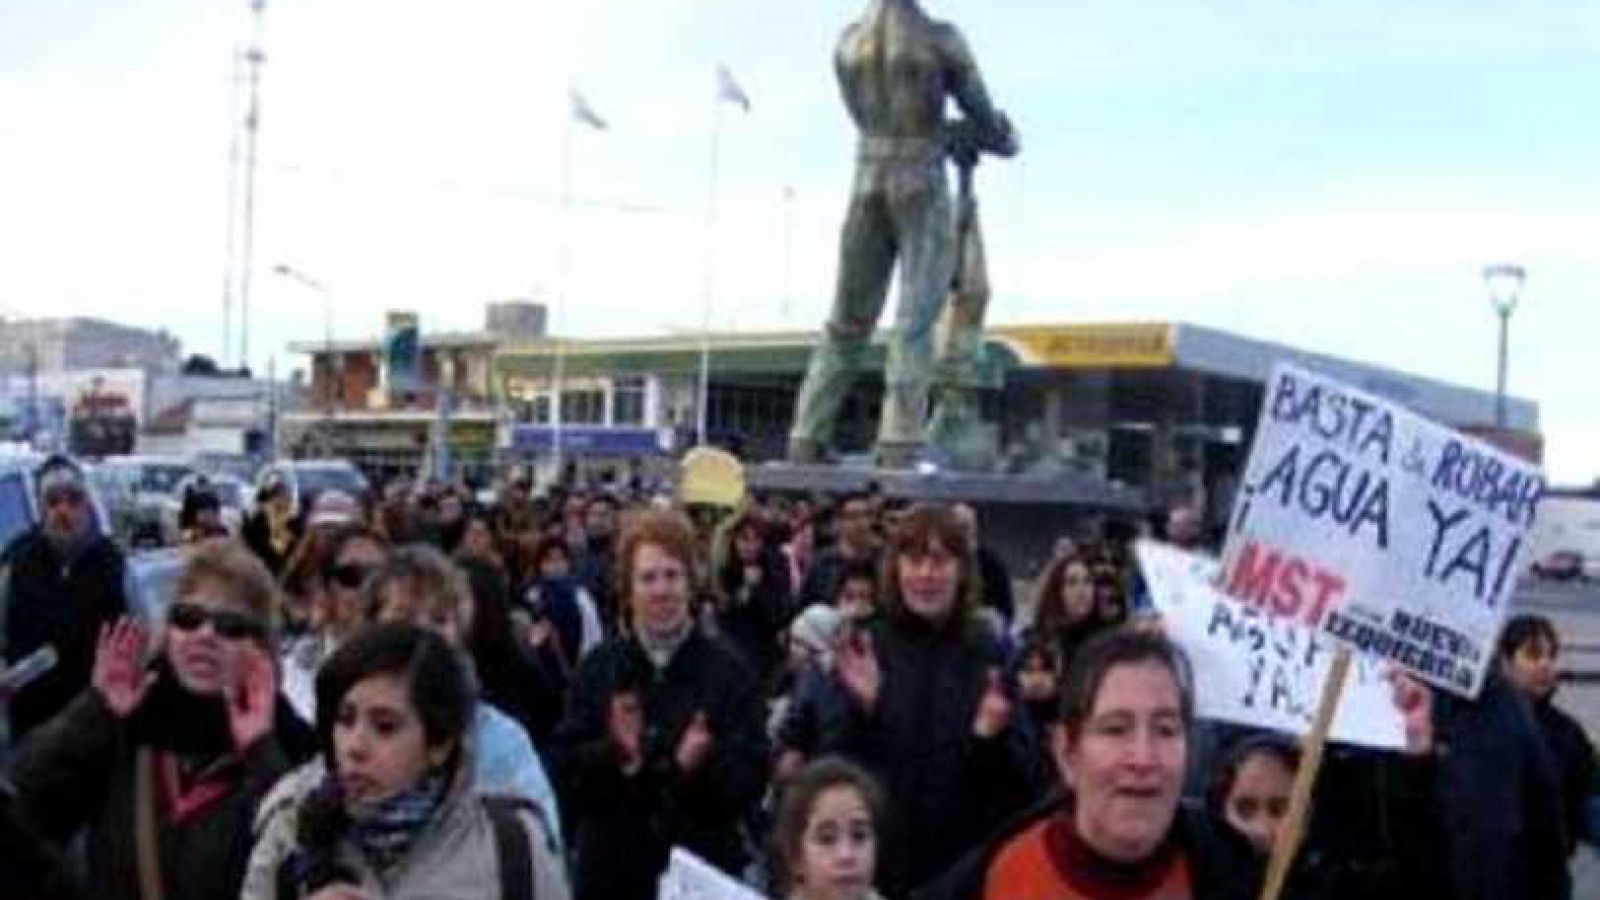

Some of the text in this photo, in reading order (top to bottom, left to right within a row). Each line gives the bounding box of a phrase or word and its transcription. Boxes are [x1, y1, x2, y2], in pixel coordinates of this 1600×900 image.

[1271, 374, 1393, 465] BASTA
[1226, 540, 1345, 628] MST
[1423, 496, 1521, 607] YA!
